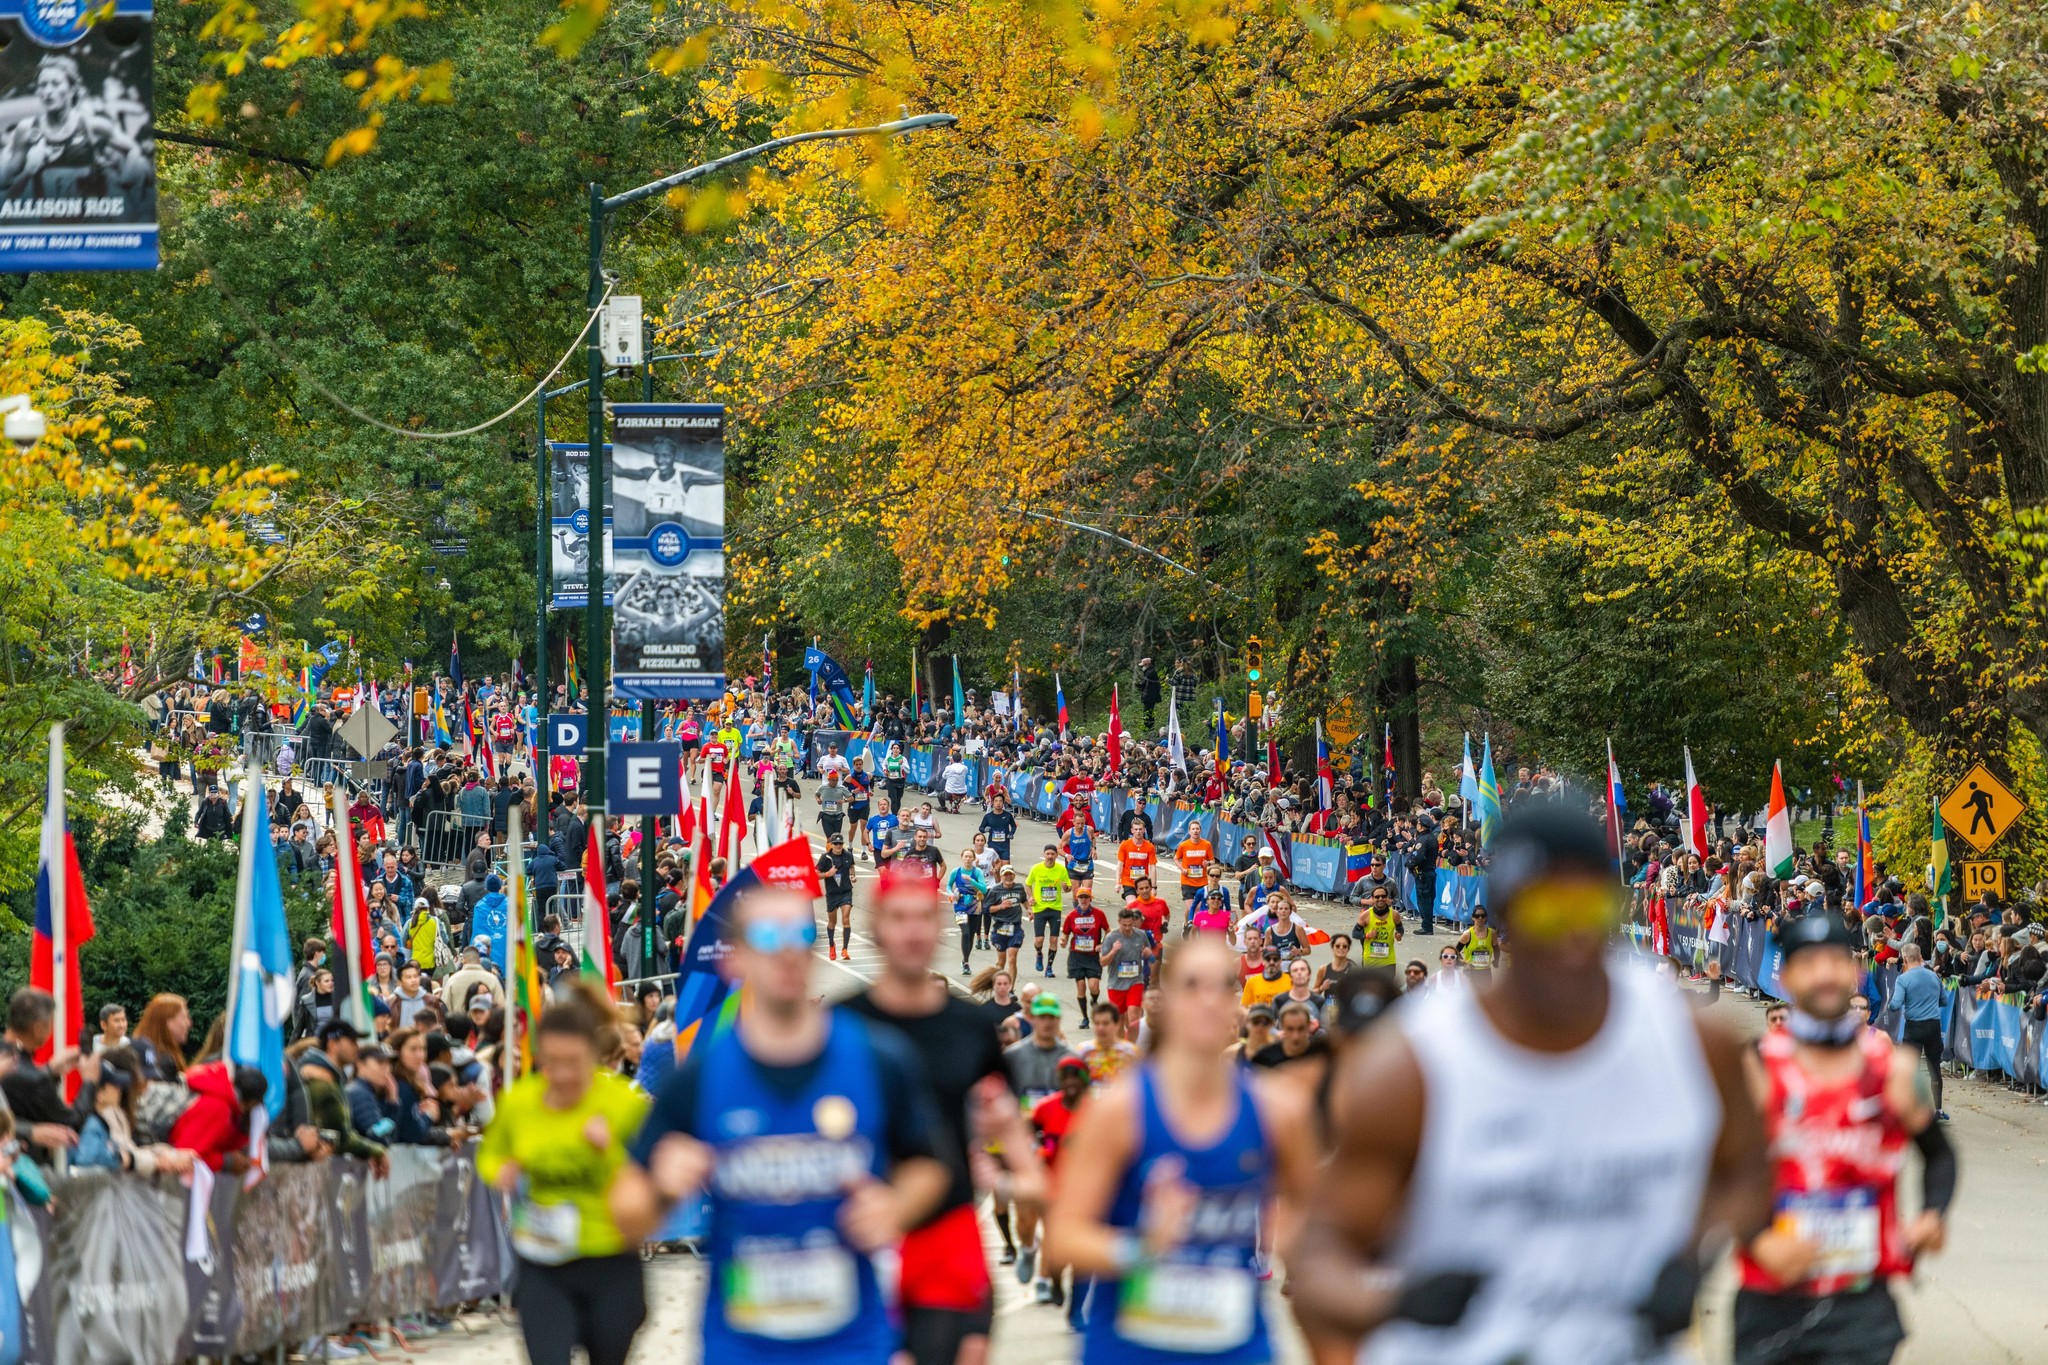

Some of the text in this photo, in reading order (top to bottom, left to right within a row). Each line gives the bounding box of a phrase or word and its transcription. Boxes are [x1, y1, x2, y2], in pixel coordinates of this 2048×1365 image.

[0, 196, 125, 218] ALLISON ROE
[14, 236, 47, 249] YORK
[48, 235, 84, 249] ROAD
[84, 234, 142, 248] RUNNERS
[617, 417, 721, 428] LORNAH KIPLAGAT
[643, 645, 697, 655] ORLANDO
[639, 658, 701, 668] PIZZOLATO
[558, 723, 579, 746] D
[627, 757, 662, 799] E
[1971, 865, 1997, 885] 10
